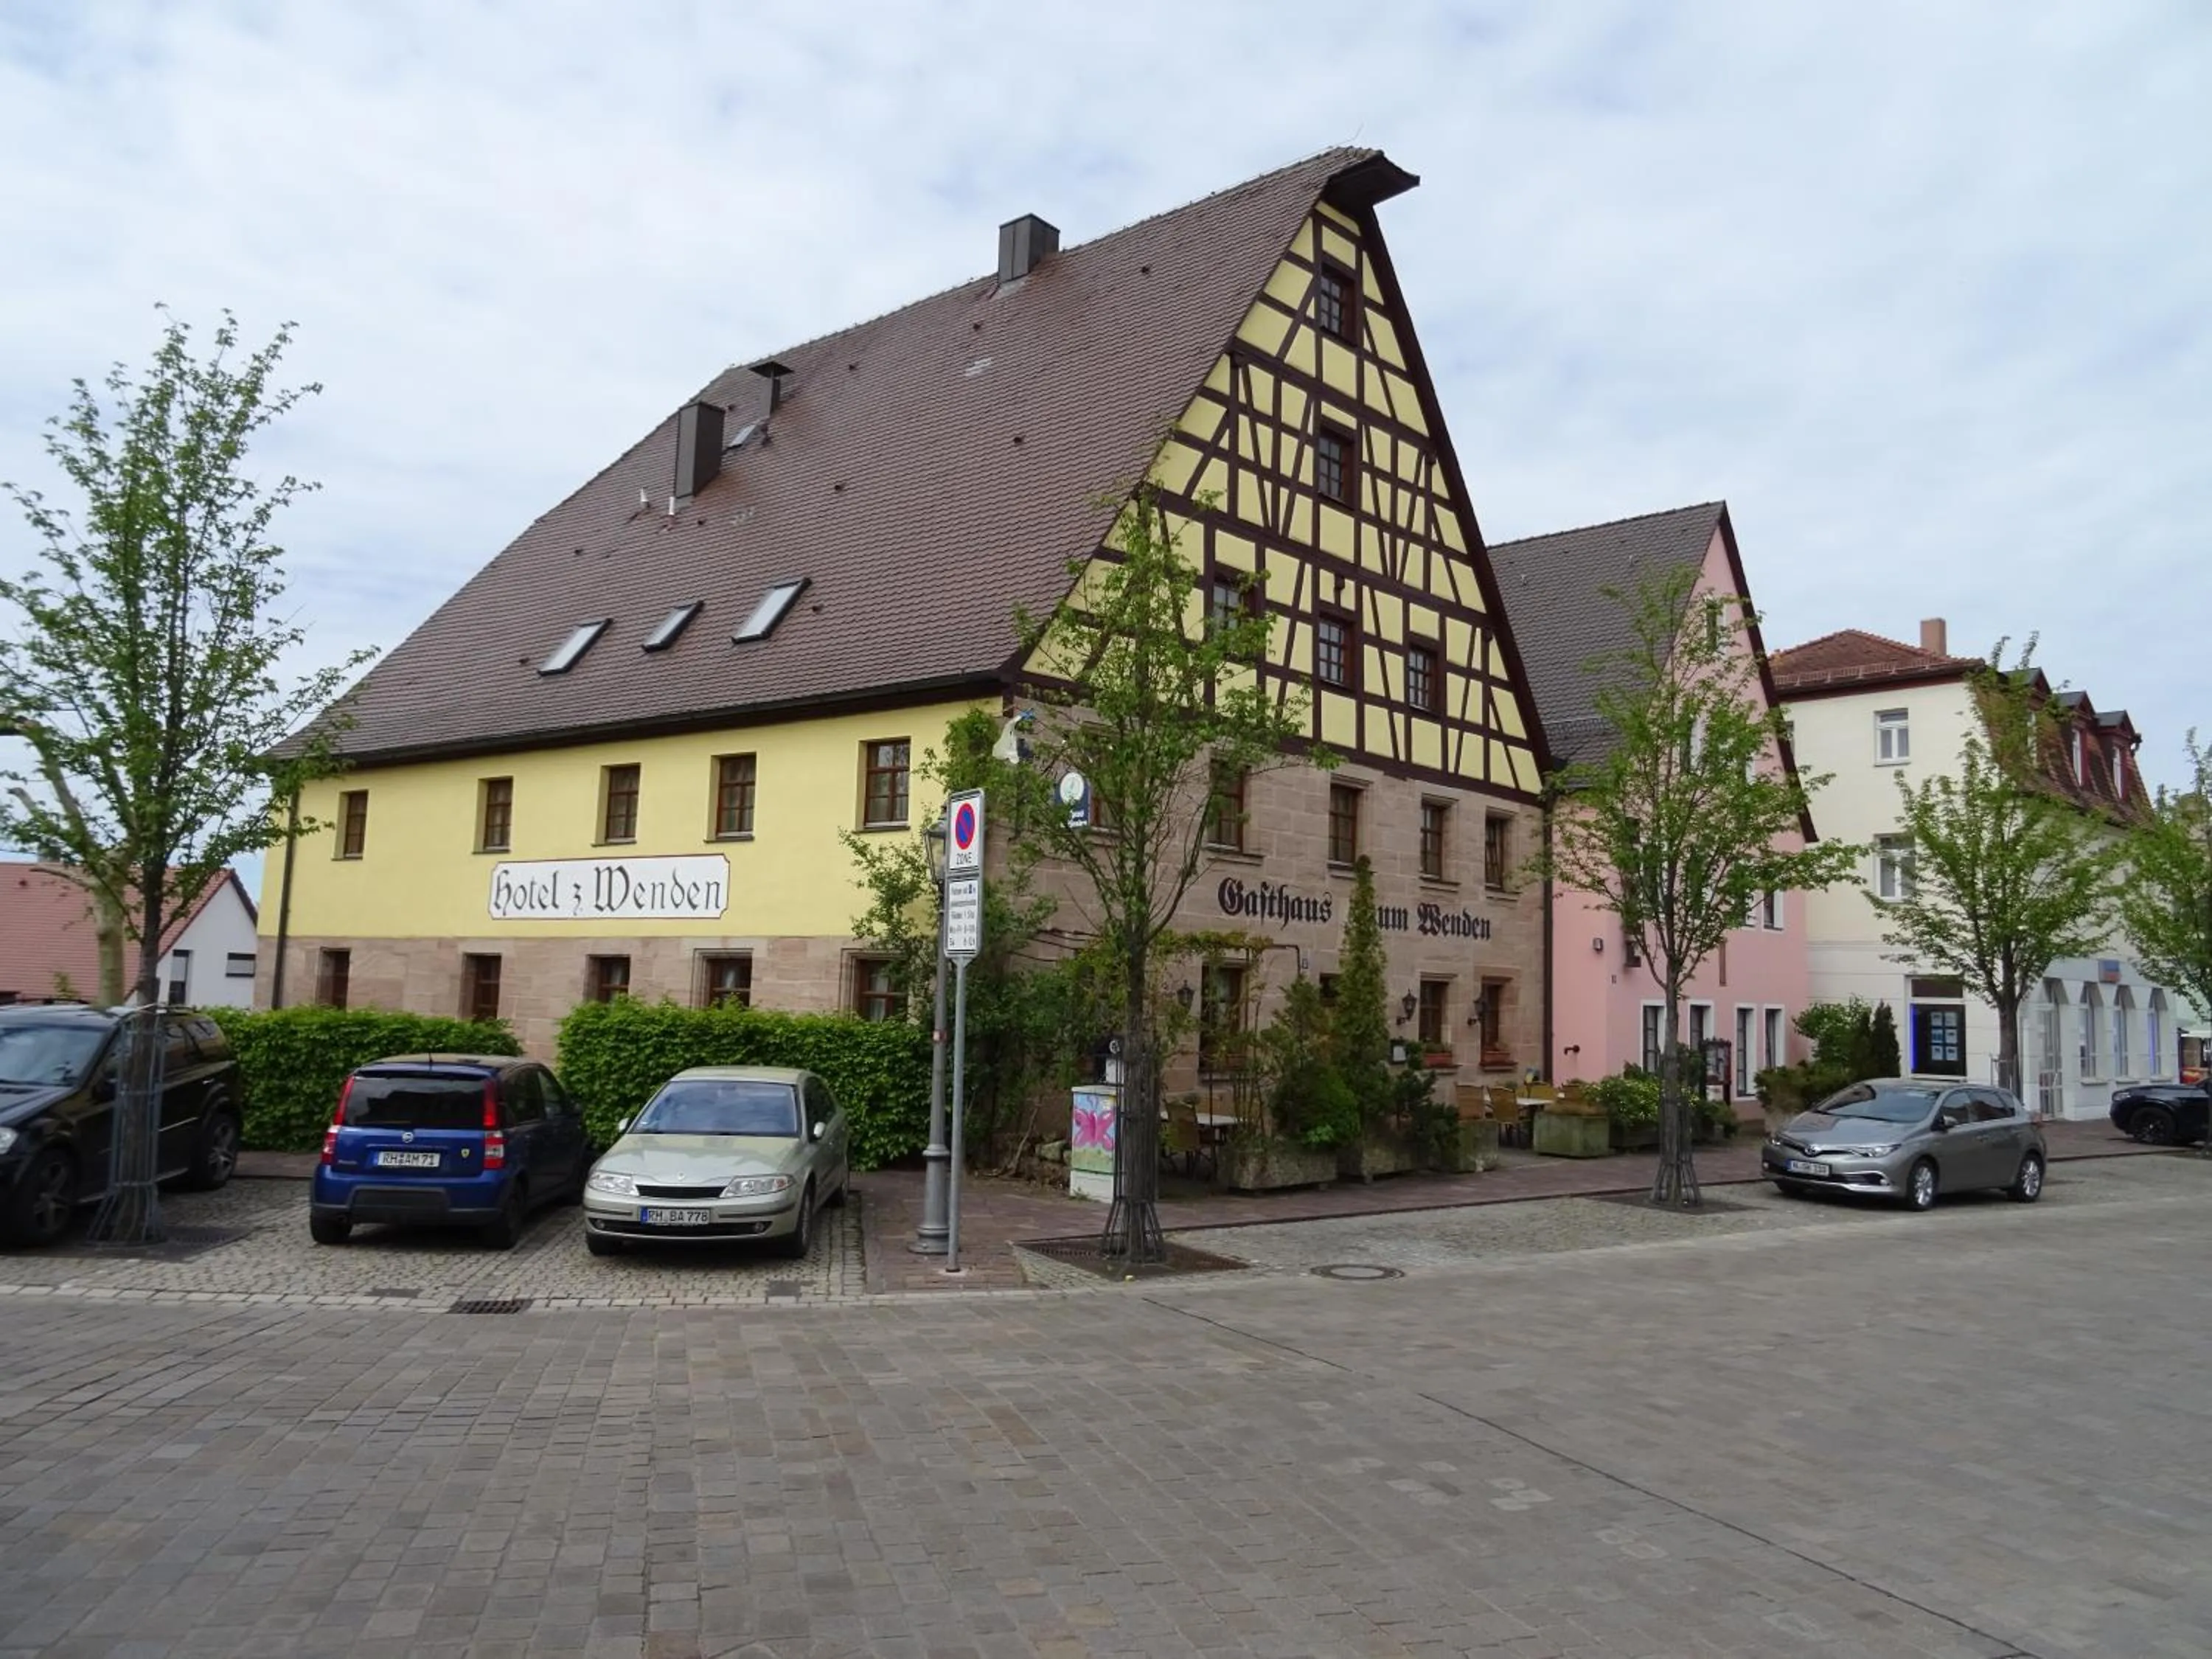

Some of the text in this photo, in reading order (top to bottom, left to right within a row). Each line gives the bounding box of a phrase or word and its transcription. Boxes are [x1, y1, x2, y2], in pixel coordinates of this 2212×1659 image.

[956, 852, 973, 865] ZONE
[493, 869, 560, 917] Hotel
[594, 865, 721, 913] Wenden
[1417, 902, 1491, 940] Wenden
